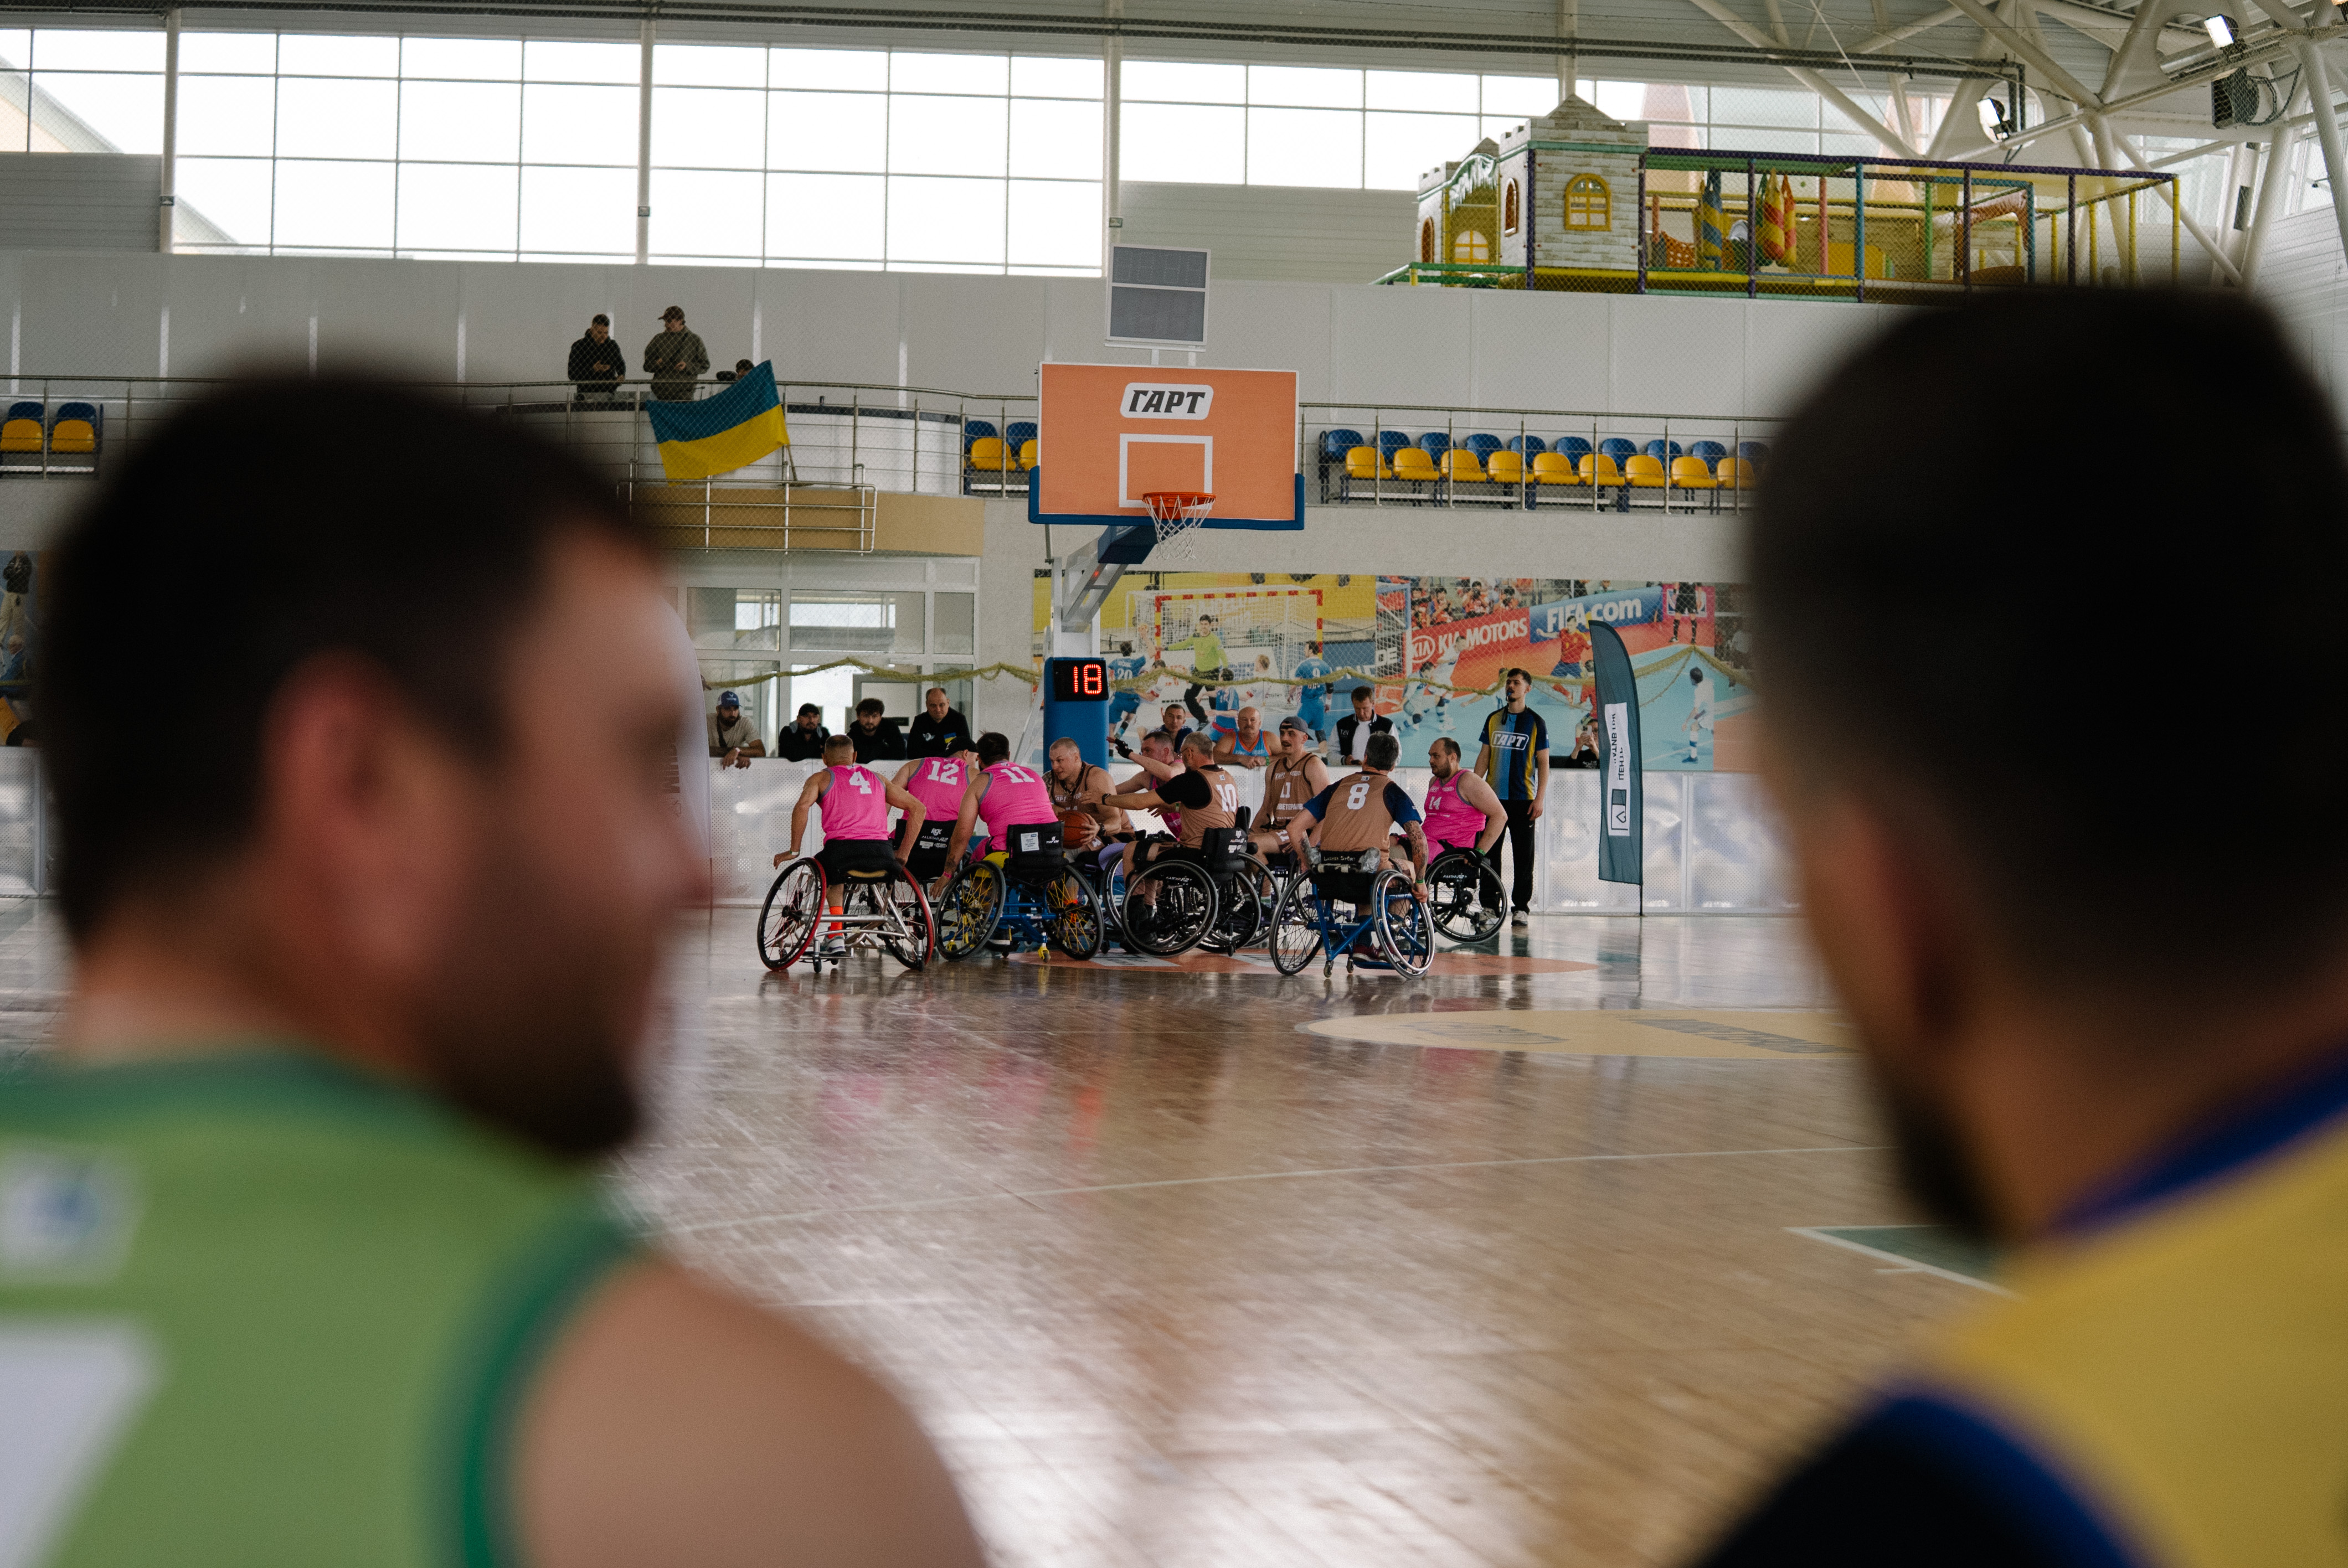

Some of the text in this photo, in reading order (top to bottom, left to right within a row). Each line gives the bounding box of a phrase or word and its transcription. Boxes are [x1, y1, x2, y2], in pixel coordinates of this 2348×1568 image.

[1129, 390, 1206, 414] ГАРТ
[1547, 598, 1642, 632] FIFAcom
[1466, 617, 1528, 647] MOTORS
[1073, 664, 1102, 694] 18
[1117, 668, 1133, 679] 20
[1493, 733, 1526, 747] ГАРТ
[849, 771, 872, 794] 4
[927, 760, 960, 785] 12
[1000, 766, 1036, 783] 11
[1216, 783, 1237, 812] 10
[1347, 783, 1369, 810] 8
[1429, 796, 1442, 809] 14
